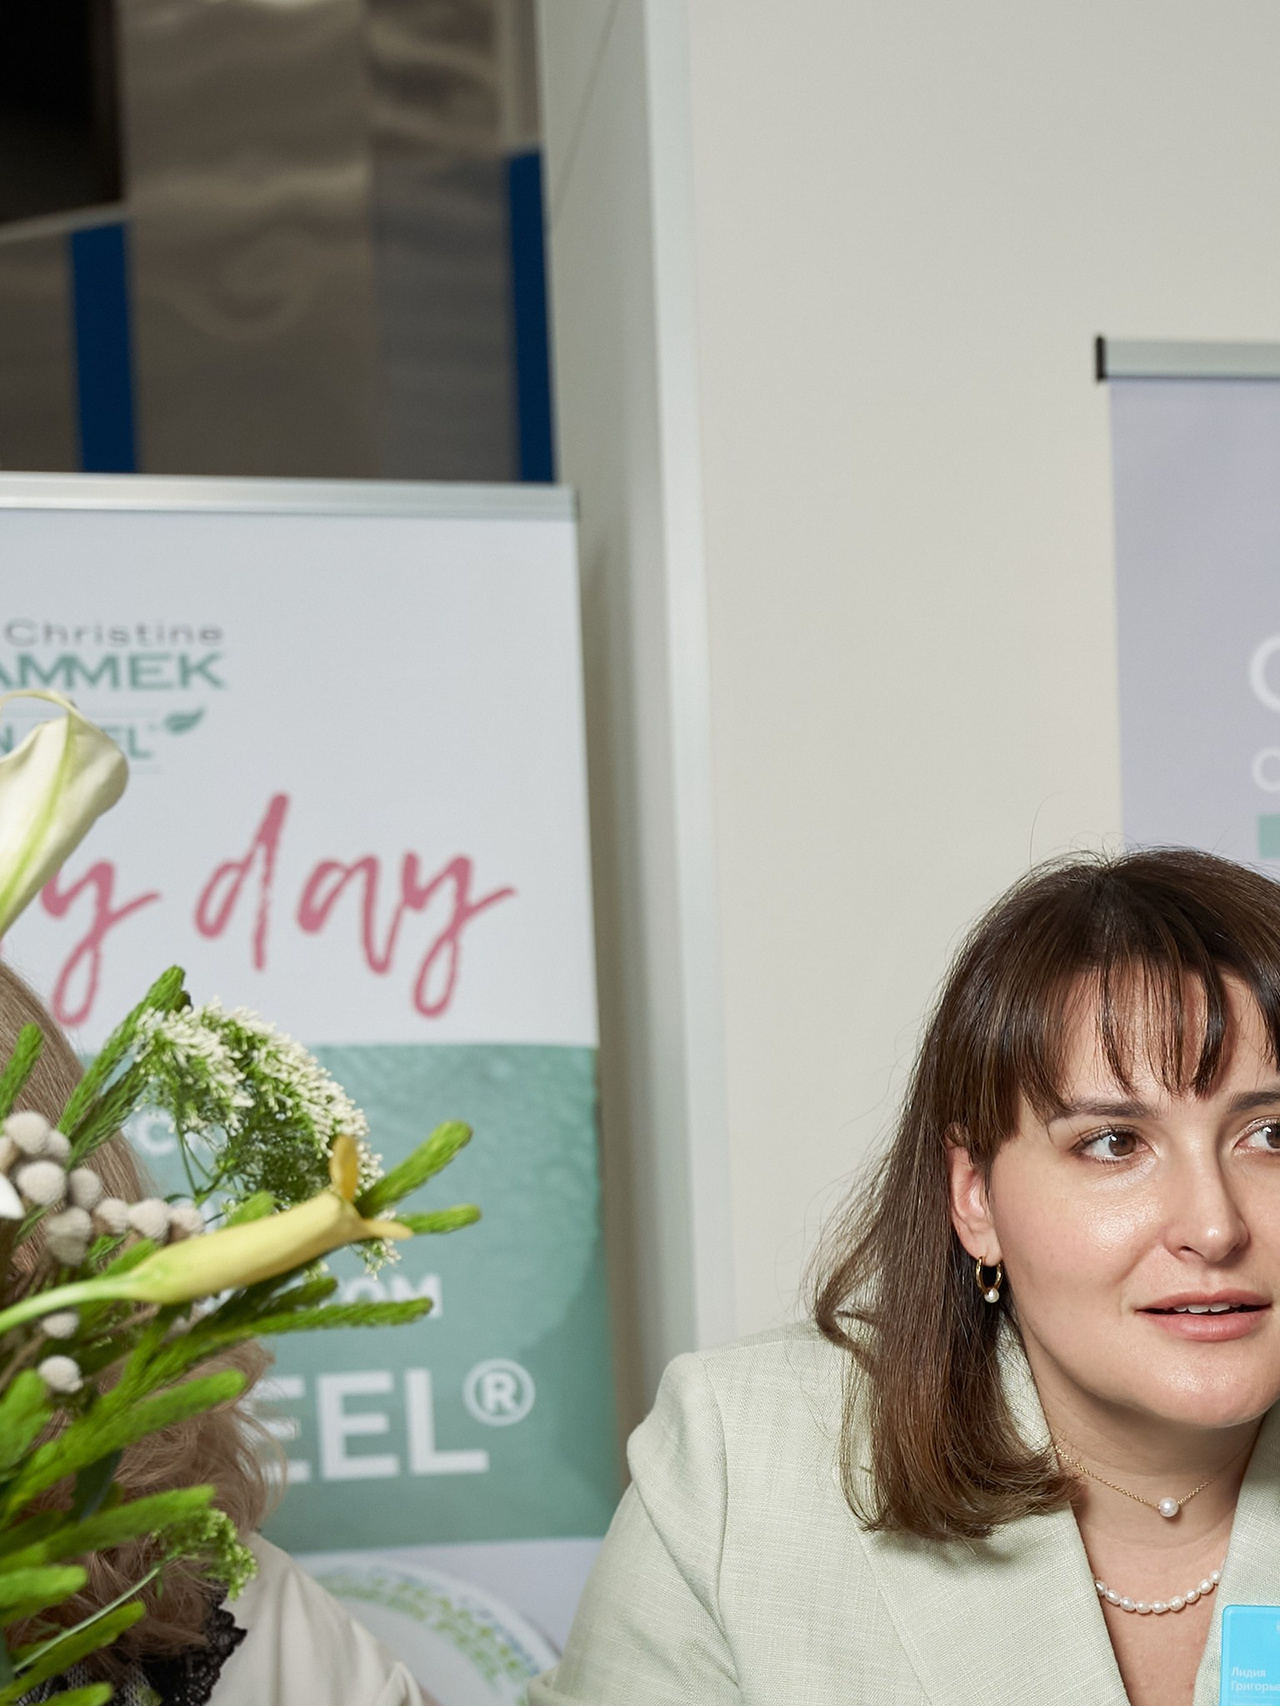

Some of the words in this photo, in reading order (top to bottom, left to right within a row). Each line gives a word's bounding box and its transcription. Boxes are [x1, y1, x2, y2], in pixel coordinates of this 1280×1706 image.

[4, 617, 223, 648] Christine
[0, 653, 226, 690] MMEK
[195, 792, 516, 1018] day
[1231, 1666, 1267, 1678] Лидия
